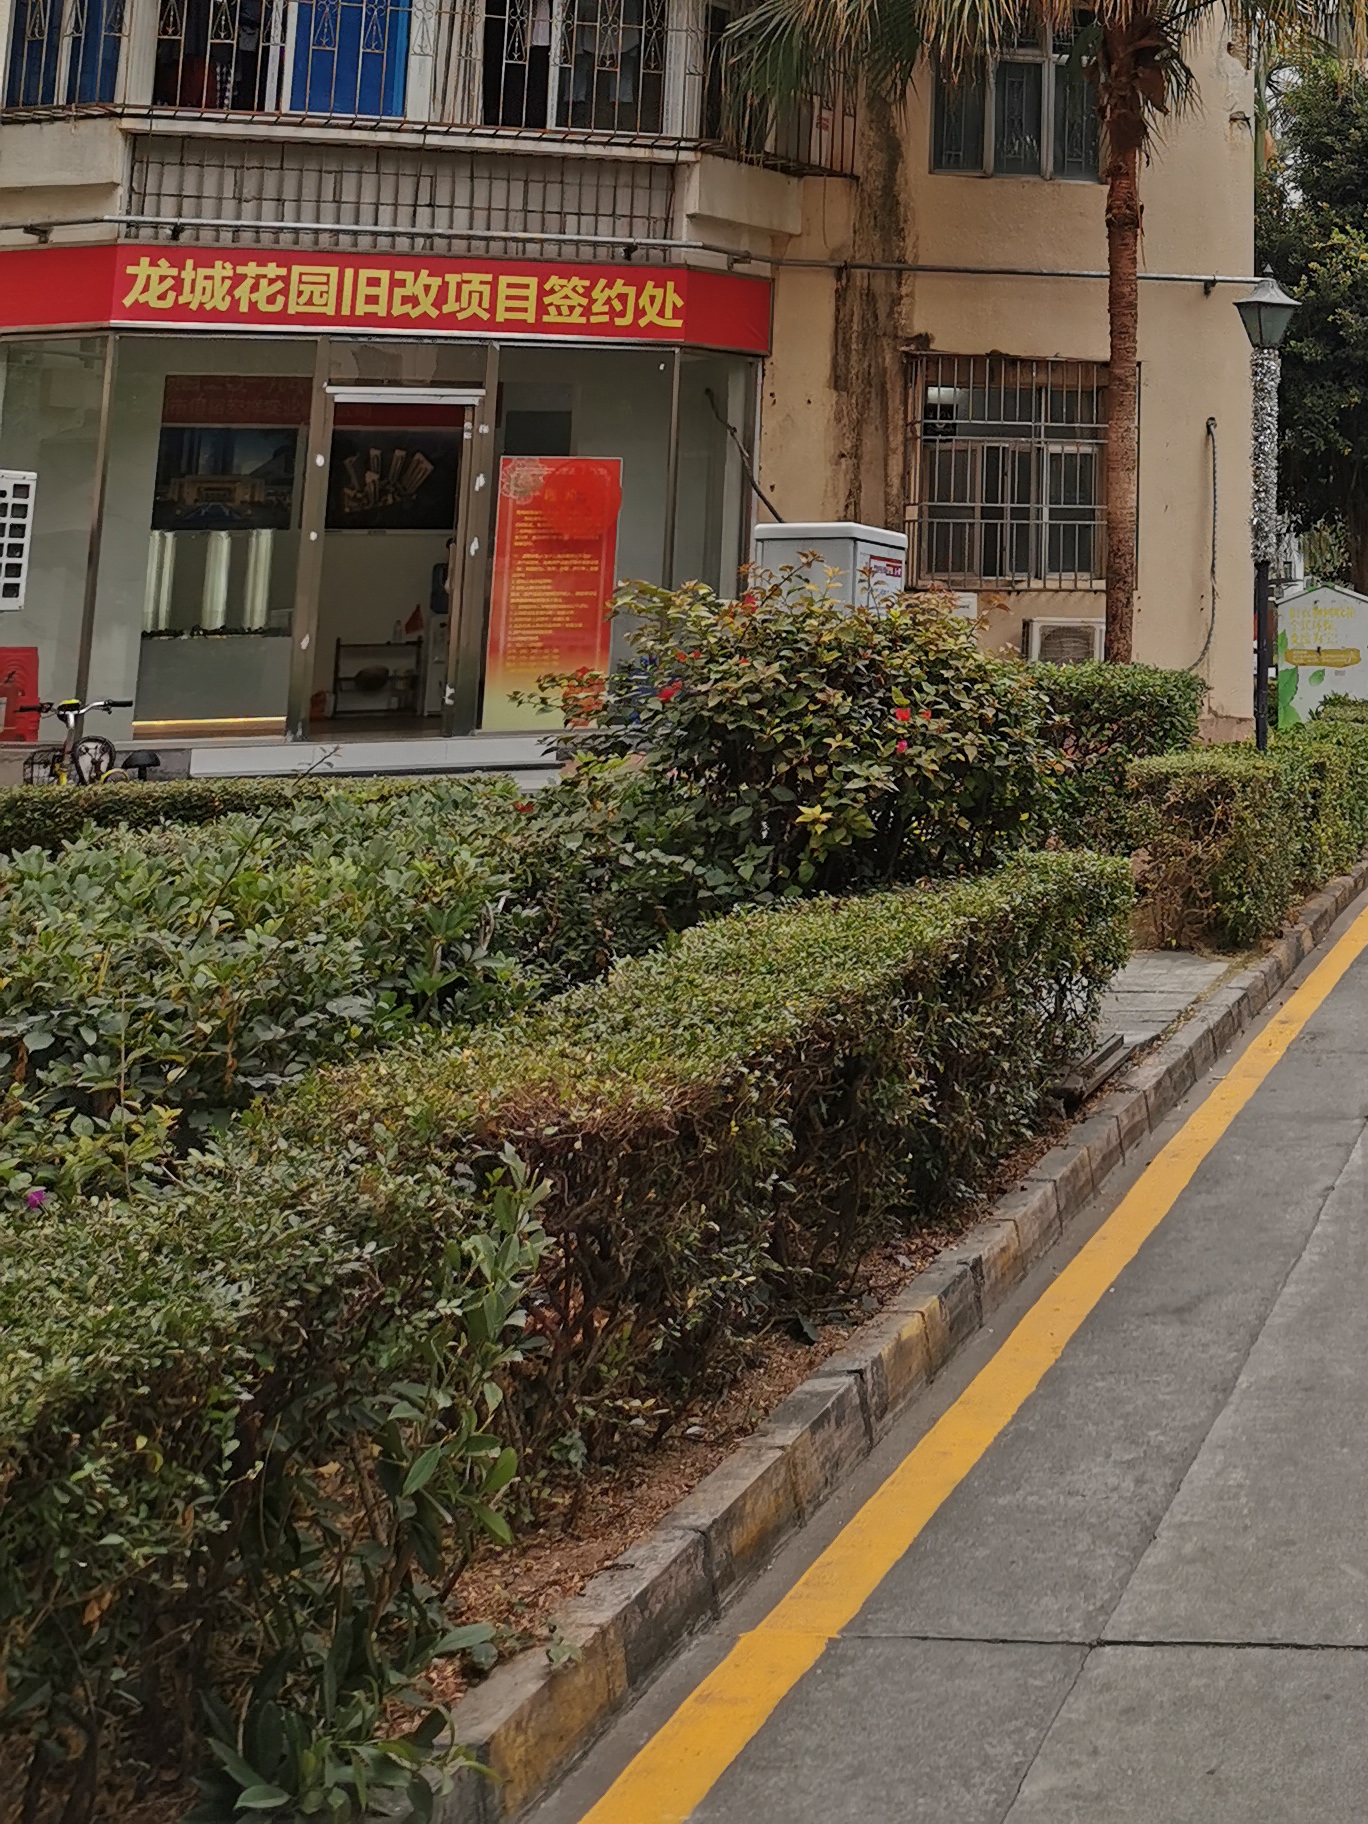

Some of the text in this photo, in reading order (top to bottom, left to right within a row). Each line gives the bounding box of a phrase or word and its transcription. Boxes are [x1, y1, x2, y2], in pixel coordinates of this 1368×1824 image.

[122, 256, 684, 328] 龙城花园旧改项目签约处
